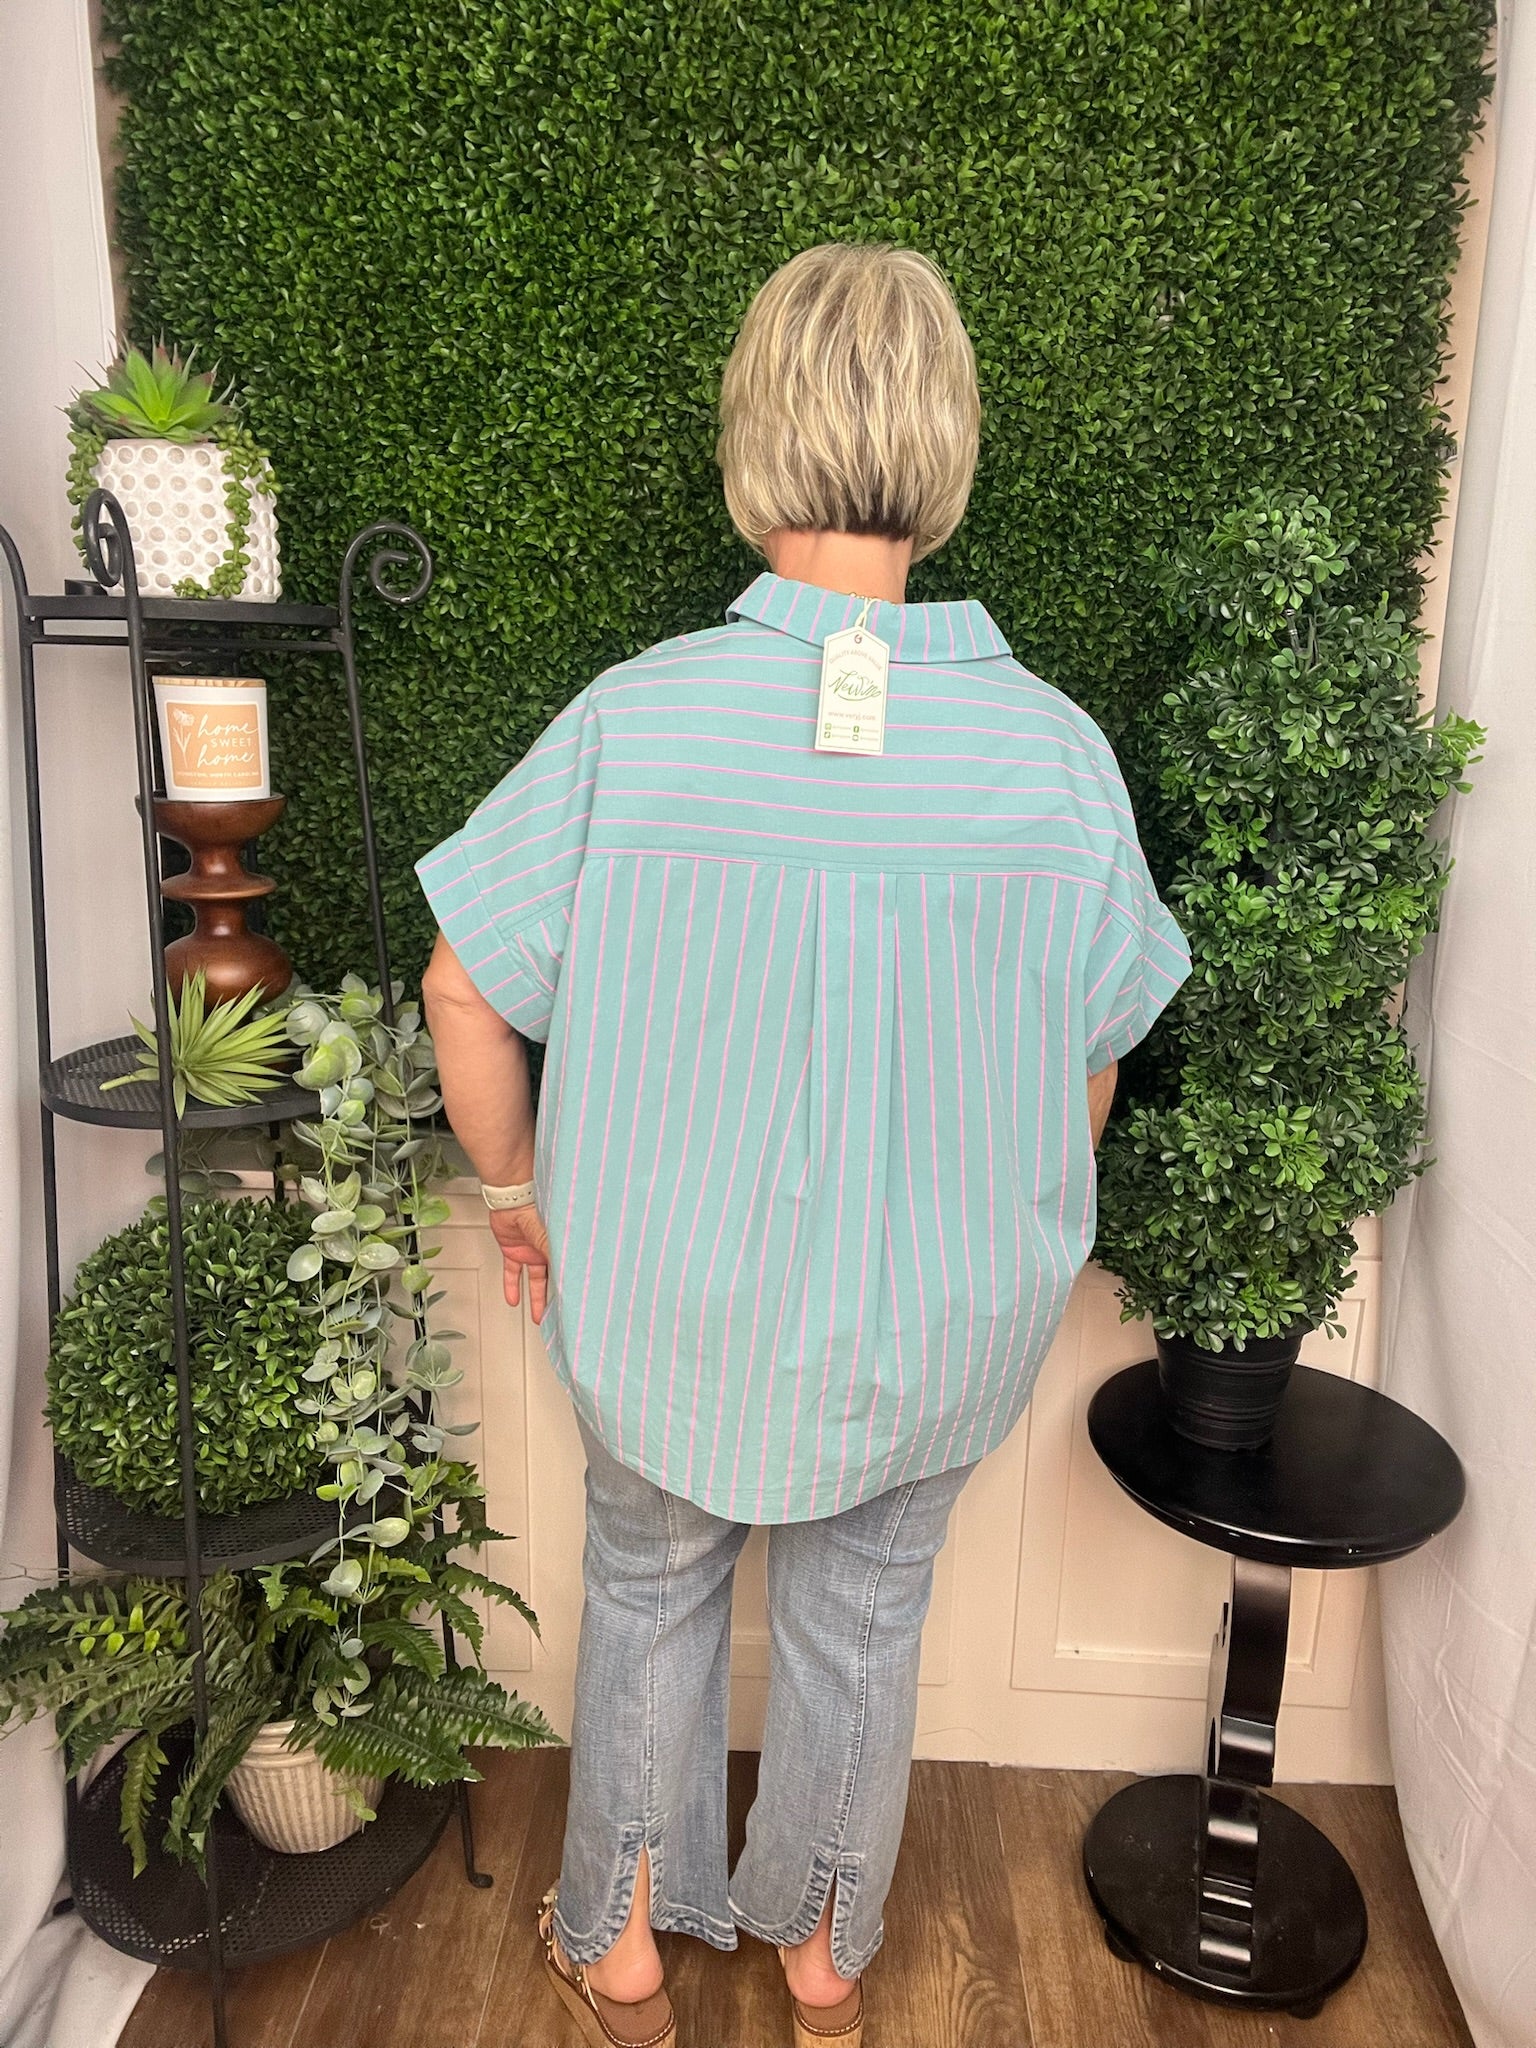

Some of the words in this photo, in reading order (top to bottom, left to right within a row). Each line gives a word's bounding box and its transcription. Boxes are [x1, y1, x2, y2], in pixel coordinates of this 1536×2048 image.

[197, 713, 259, 738] home
[211, 737, 252, 748] SWEET
[197, 744, 255, 768] home
